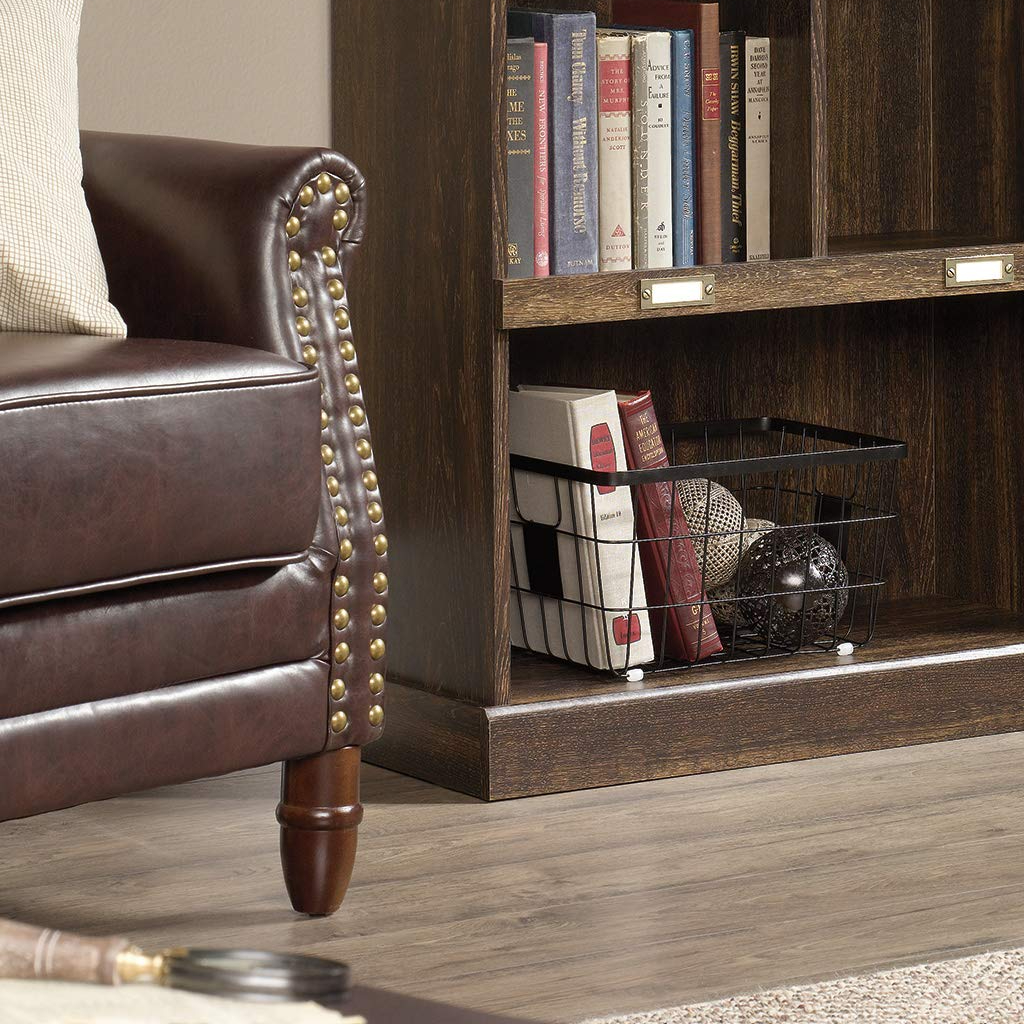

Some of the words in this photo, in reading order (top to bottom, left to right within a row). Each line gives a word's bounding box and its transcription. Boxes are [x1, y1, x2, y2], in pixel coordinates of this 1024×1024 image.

[571, 29, 587, 60] Tom
[647, 59, 670, 71] ADVICE
[730, 45, 739, 80] IRWIN
[507, 89, 518, 97] HE
[567, 61, 587, 104] Clancy
[648, 86, 670, 99] FAILURE
[507, 101, 525, 113] ME
[730, 82, 739, 116] SHAW
[507, 130, 527, 142] XES
[539, 118, 547, 173] FRONTIERS
[572, 117, 587, 171] Without
[640, 100, 648, 210] SOUNDER
[573, 172, 588, 234] Remorse
[731, 193, 743, 227] Thief
[635, 422, 658, 440] AMERICAN
[640, 413, 650, 425] THE
